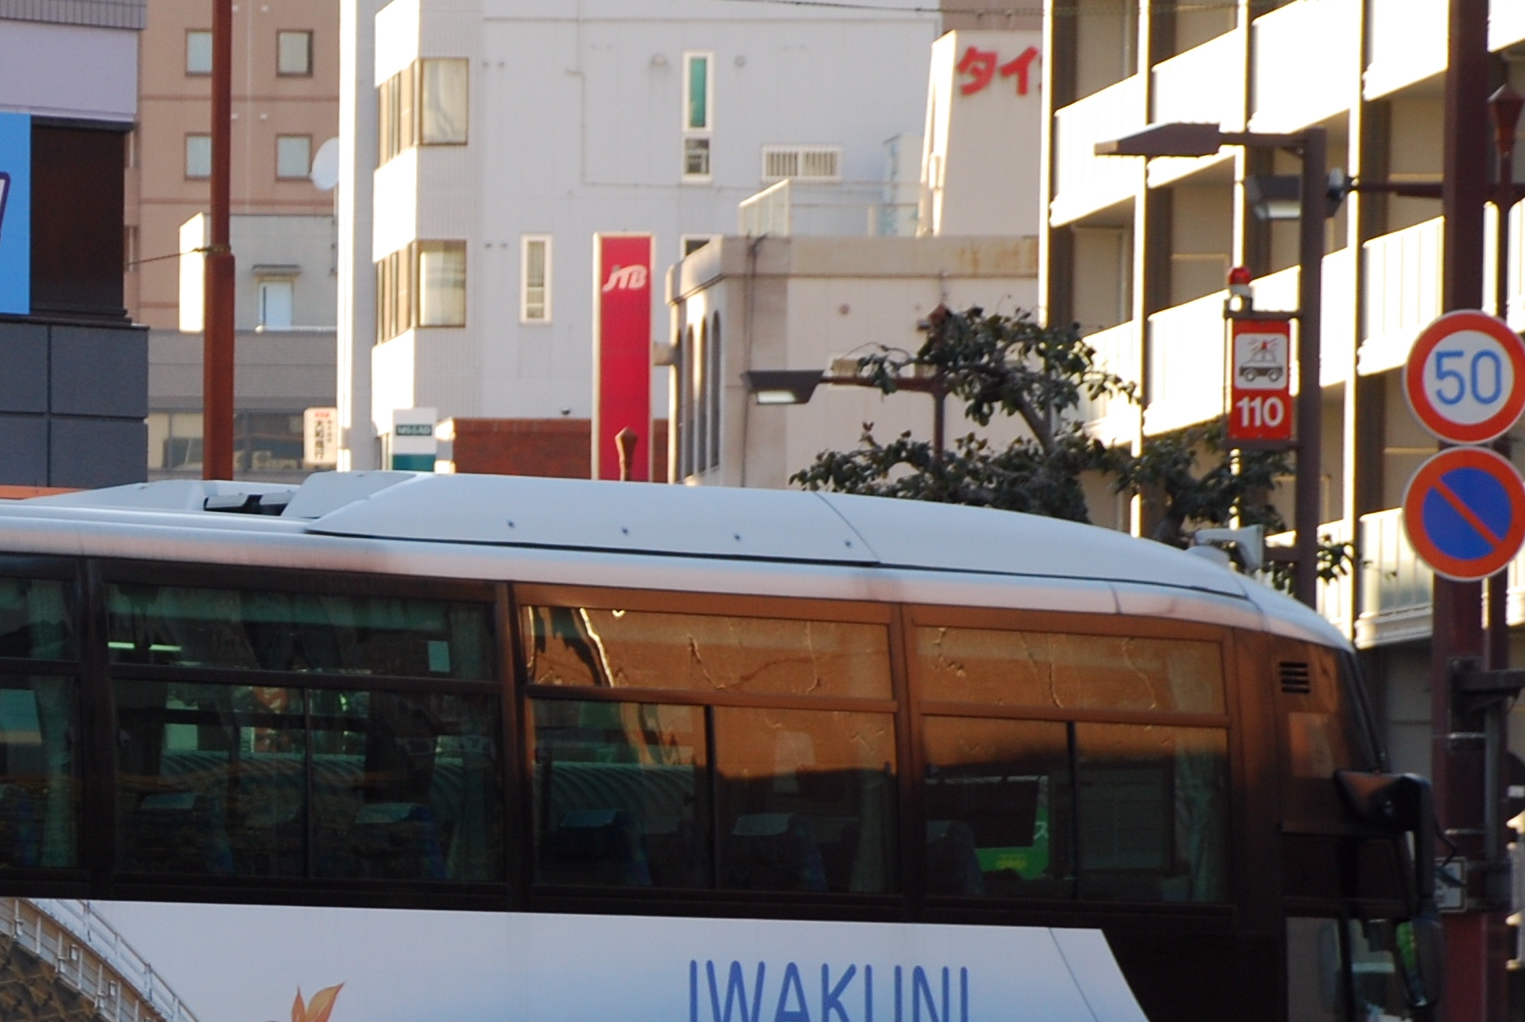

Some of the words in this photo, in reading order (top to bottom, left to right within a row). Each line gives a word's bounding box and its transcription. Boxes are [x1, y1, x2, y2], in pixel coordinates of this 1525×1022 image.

[956, 43, 1042, 96] タイ
[601, 264, 648, 292] JTB
[1433, 350, 1503, 406] 50
[1237, 397, 1284, 428] 110
